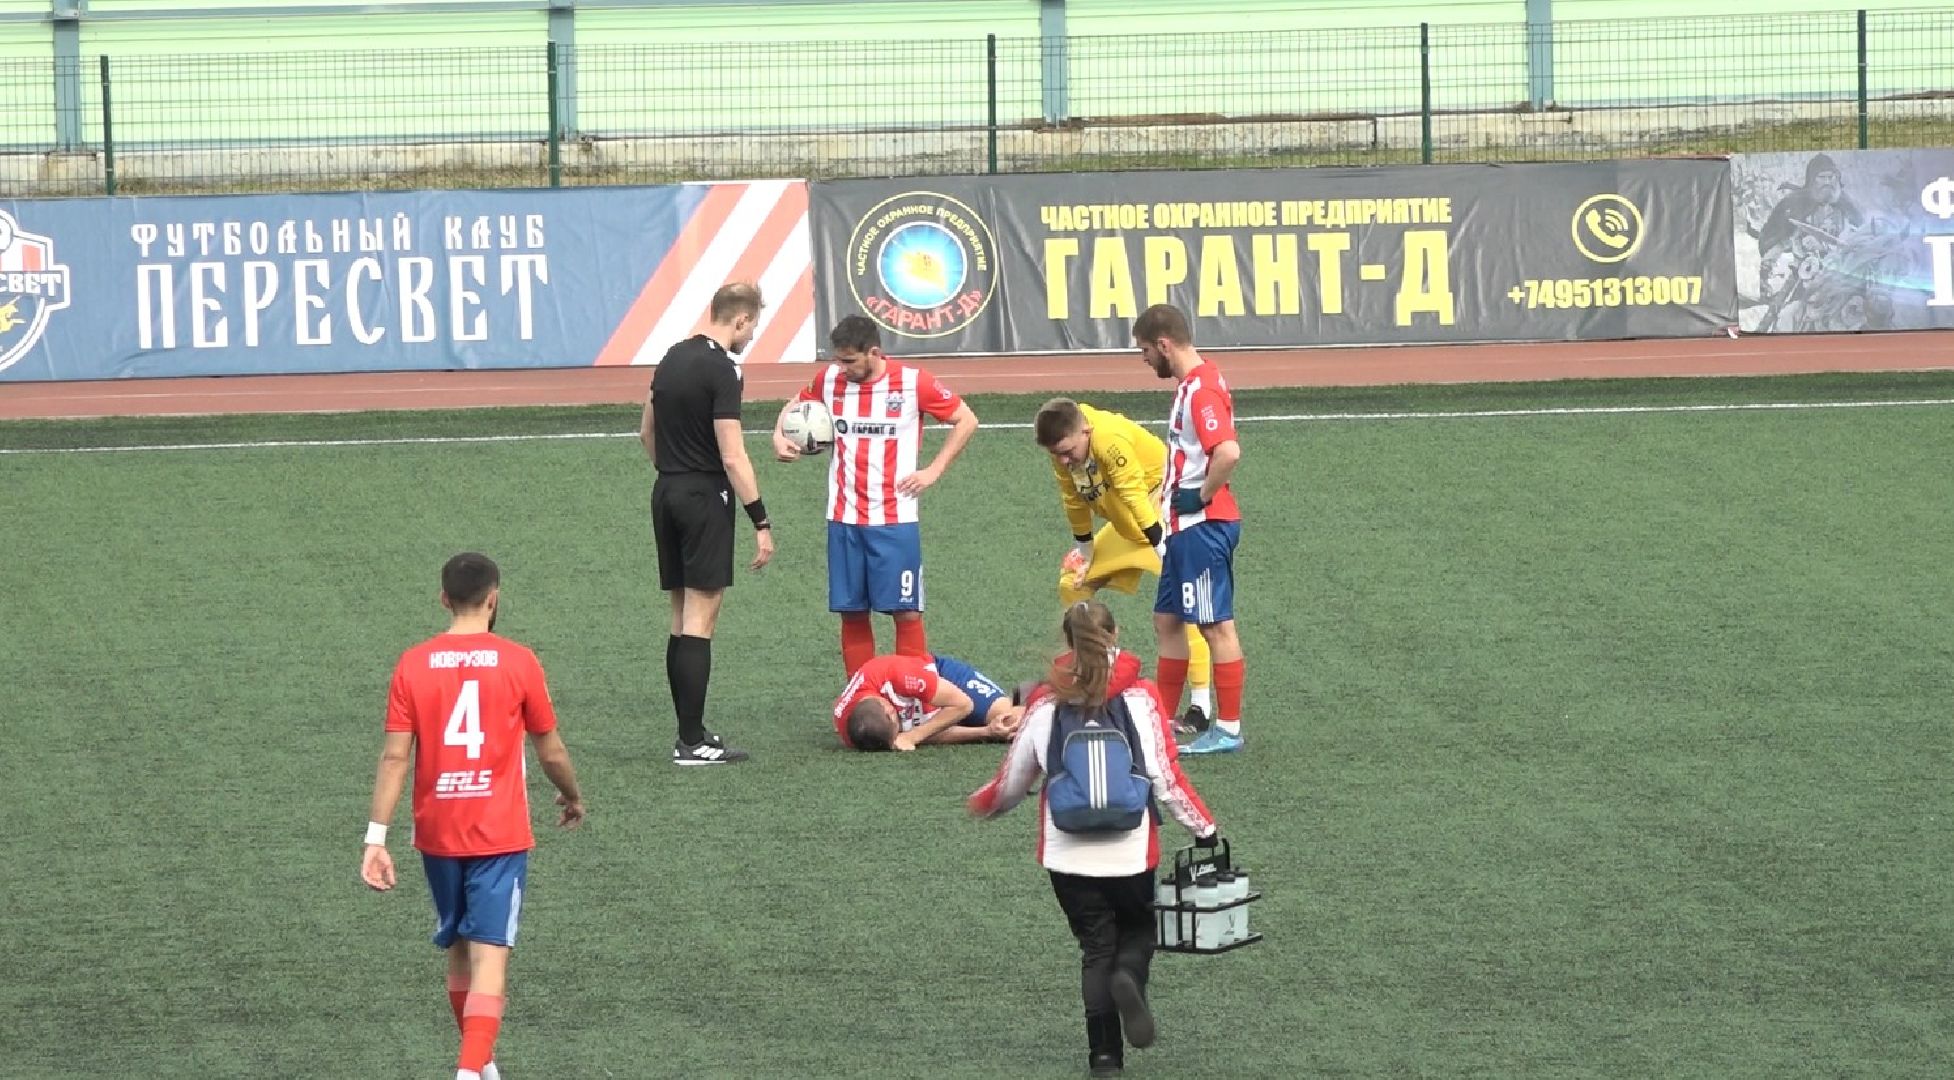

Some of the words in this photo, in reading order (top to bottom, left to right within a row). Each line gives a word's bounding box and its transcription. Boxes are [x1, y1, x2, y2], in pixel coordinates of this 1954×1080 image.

[1040, 205, 1150, 231] ЧАСТНОЕ
[1153, 201, 1278, 229] ОХРАННОЕ
[1281, 197, 1453, 228] ПРЕДПРИЯТИЕ
[130, 212, 411, 258] ФУТБОЛЬНЫЙ
[444, 214, 545, 250] КЛУБ
[857, 226, 880, 276] ЧАСТНОЕ
[876, 205, 934, 228] ОХРАННОЕ
[936, 207, 988, 271] ПРЕДПРИЯТИЕ
[1043, 231, 1454, 326] ГАРАНТ-Д
[1507, 276, 1702, 309] +74951313007
[136, 254, 548, 349] ПЕРЕСВЕТ
[901, 569, 913, 597] 9
[1182, 582, 1195, 608] 8
[429, 649, 499, 669] НОВРУЗОВ
[443, 679, 485, 759] 4
